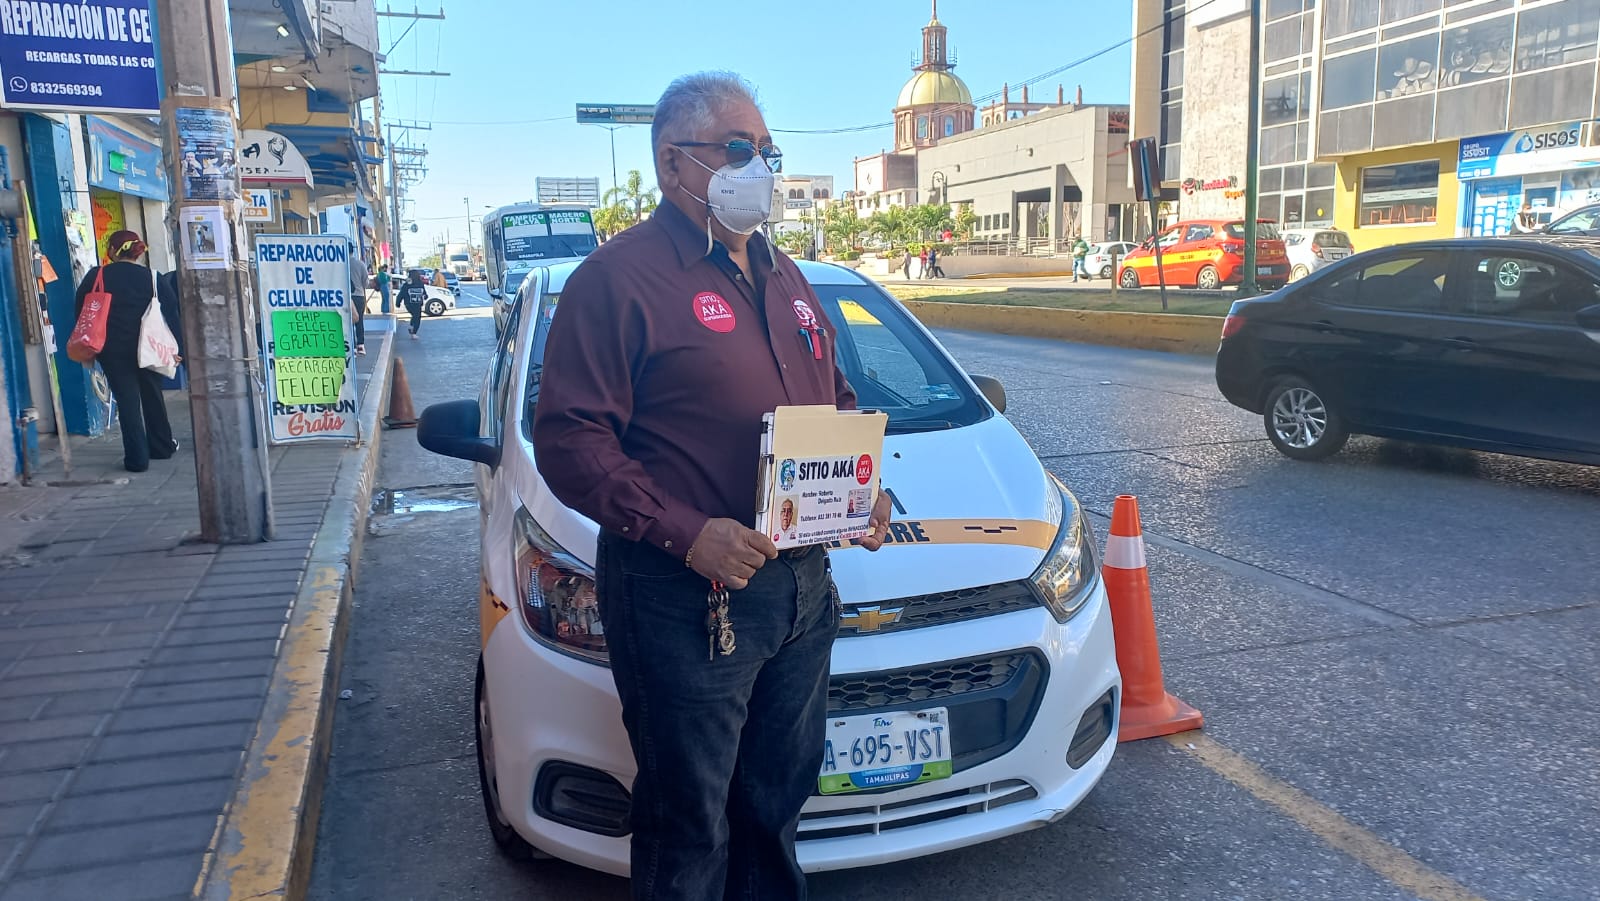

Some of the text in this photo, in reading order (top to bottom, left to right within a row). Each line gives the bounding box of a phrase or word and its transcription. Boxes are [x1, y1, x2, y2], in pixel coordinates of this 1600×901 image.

[0, 0, 105, 40] REPARACIÓN
[106, 6, 128, 42] DE
[25, 50, 82, 65] RECARGAS
[83, 53, 118, 67] TODAS
[120, 55, 139, 68] LAS
[30, 82, 102, 97] 8332569394
[504, 213, 544, 223] TAMPICO
[512, 218, 541, 226] PLAYA
[259, 240, 345, 262] REPARACIÓN
[295, 267, 314, 284] DE
[268, 289, 344, 307] CELULARES
[294, 311, 321, 322] CHIP
[288, 321, 336, 332] TELCEL
[279, 333, 339, 351] GRATIS
[278, 359, 343, 374] RECARGAS
[278, 376, 340, 398] TELCEL
[287, 410, 345, 436] Gratis
[799, 456, 854, 480] SITIO AKÁ
[864, 772, 910, 785] TAMAULIPAS
